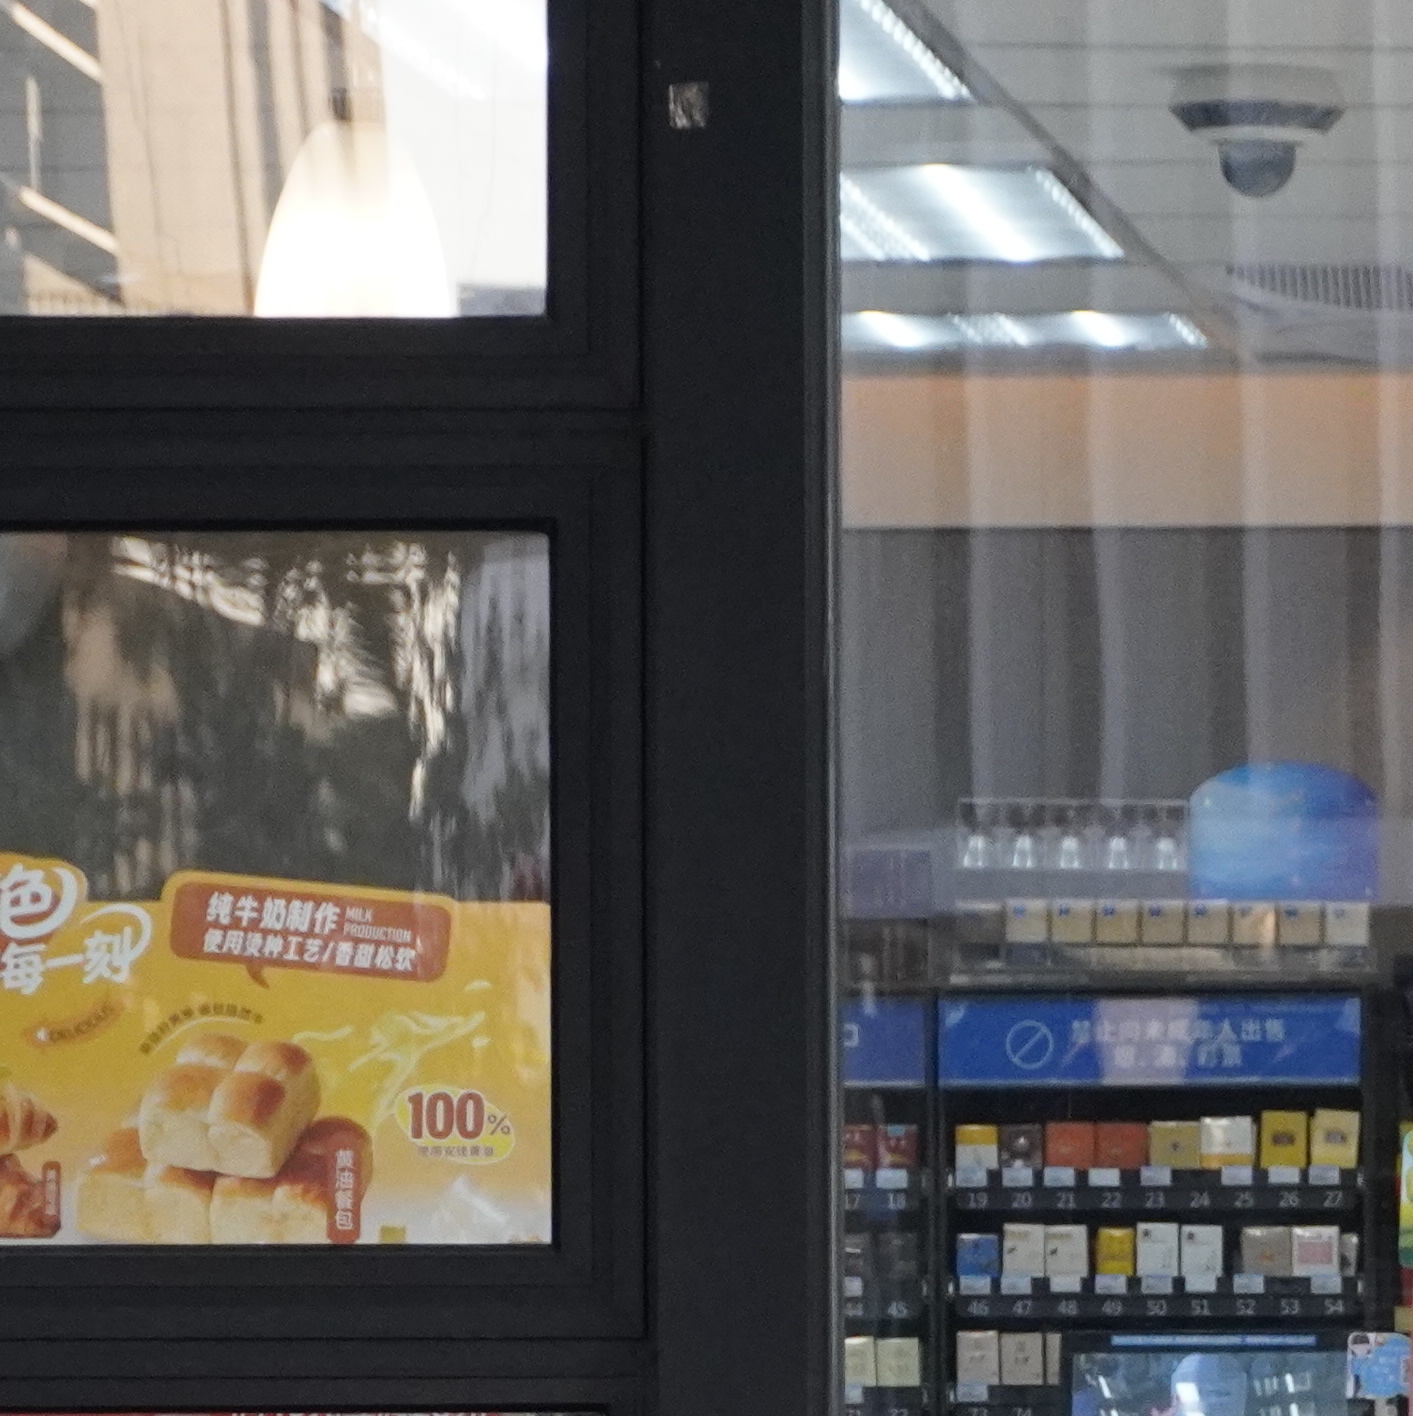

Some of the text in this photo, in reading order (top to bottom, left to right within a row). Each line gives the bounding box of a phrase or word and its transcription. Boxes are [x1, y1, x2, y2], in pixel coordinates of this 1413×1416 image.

[206, 891, 341, 934] 纯牛奶制作
[408, 1090, 511, 1140] 100%
